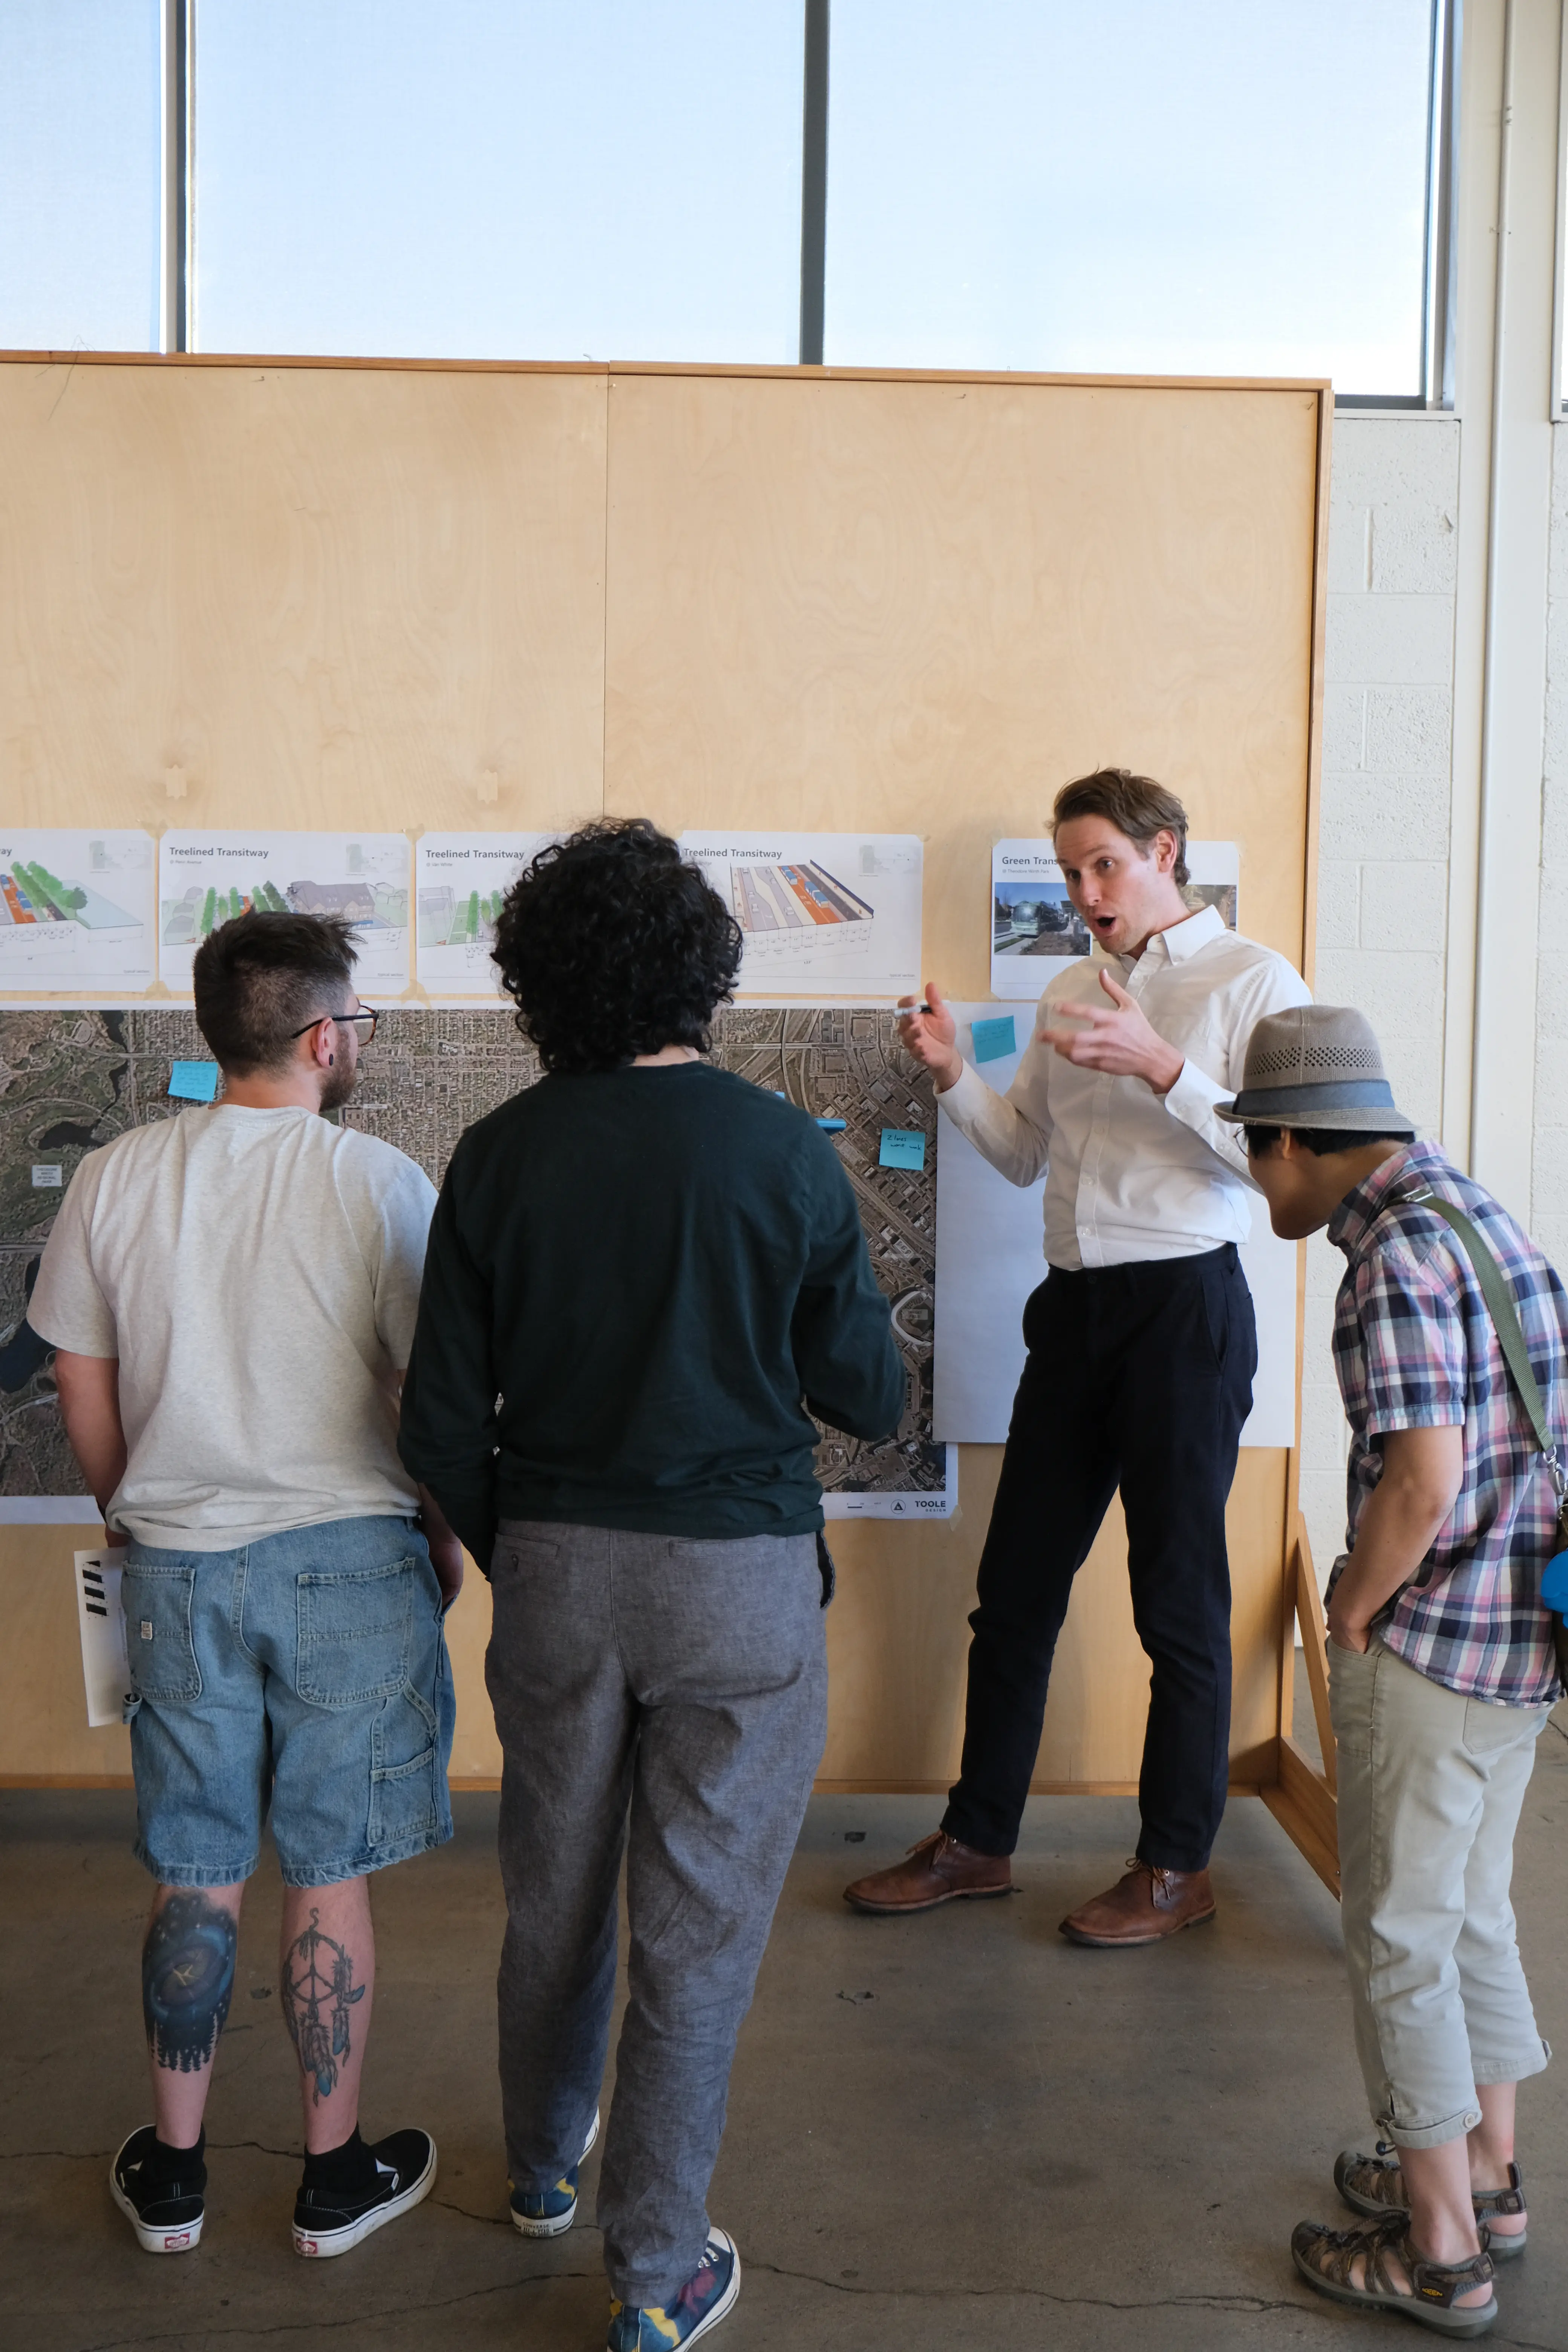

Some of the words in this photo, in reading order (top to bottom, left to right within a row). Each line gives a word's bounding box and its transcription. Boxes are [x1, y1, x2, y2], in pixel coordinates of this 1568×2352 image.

[216, 848, 269, 859] Transitway
[473, 850, 525, 860] Transitway
[730, 849, 782, 860] Transitway
[1002, 856, 1030, 865] Green
